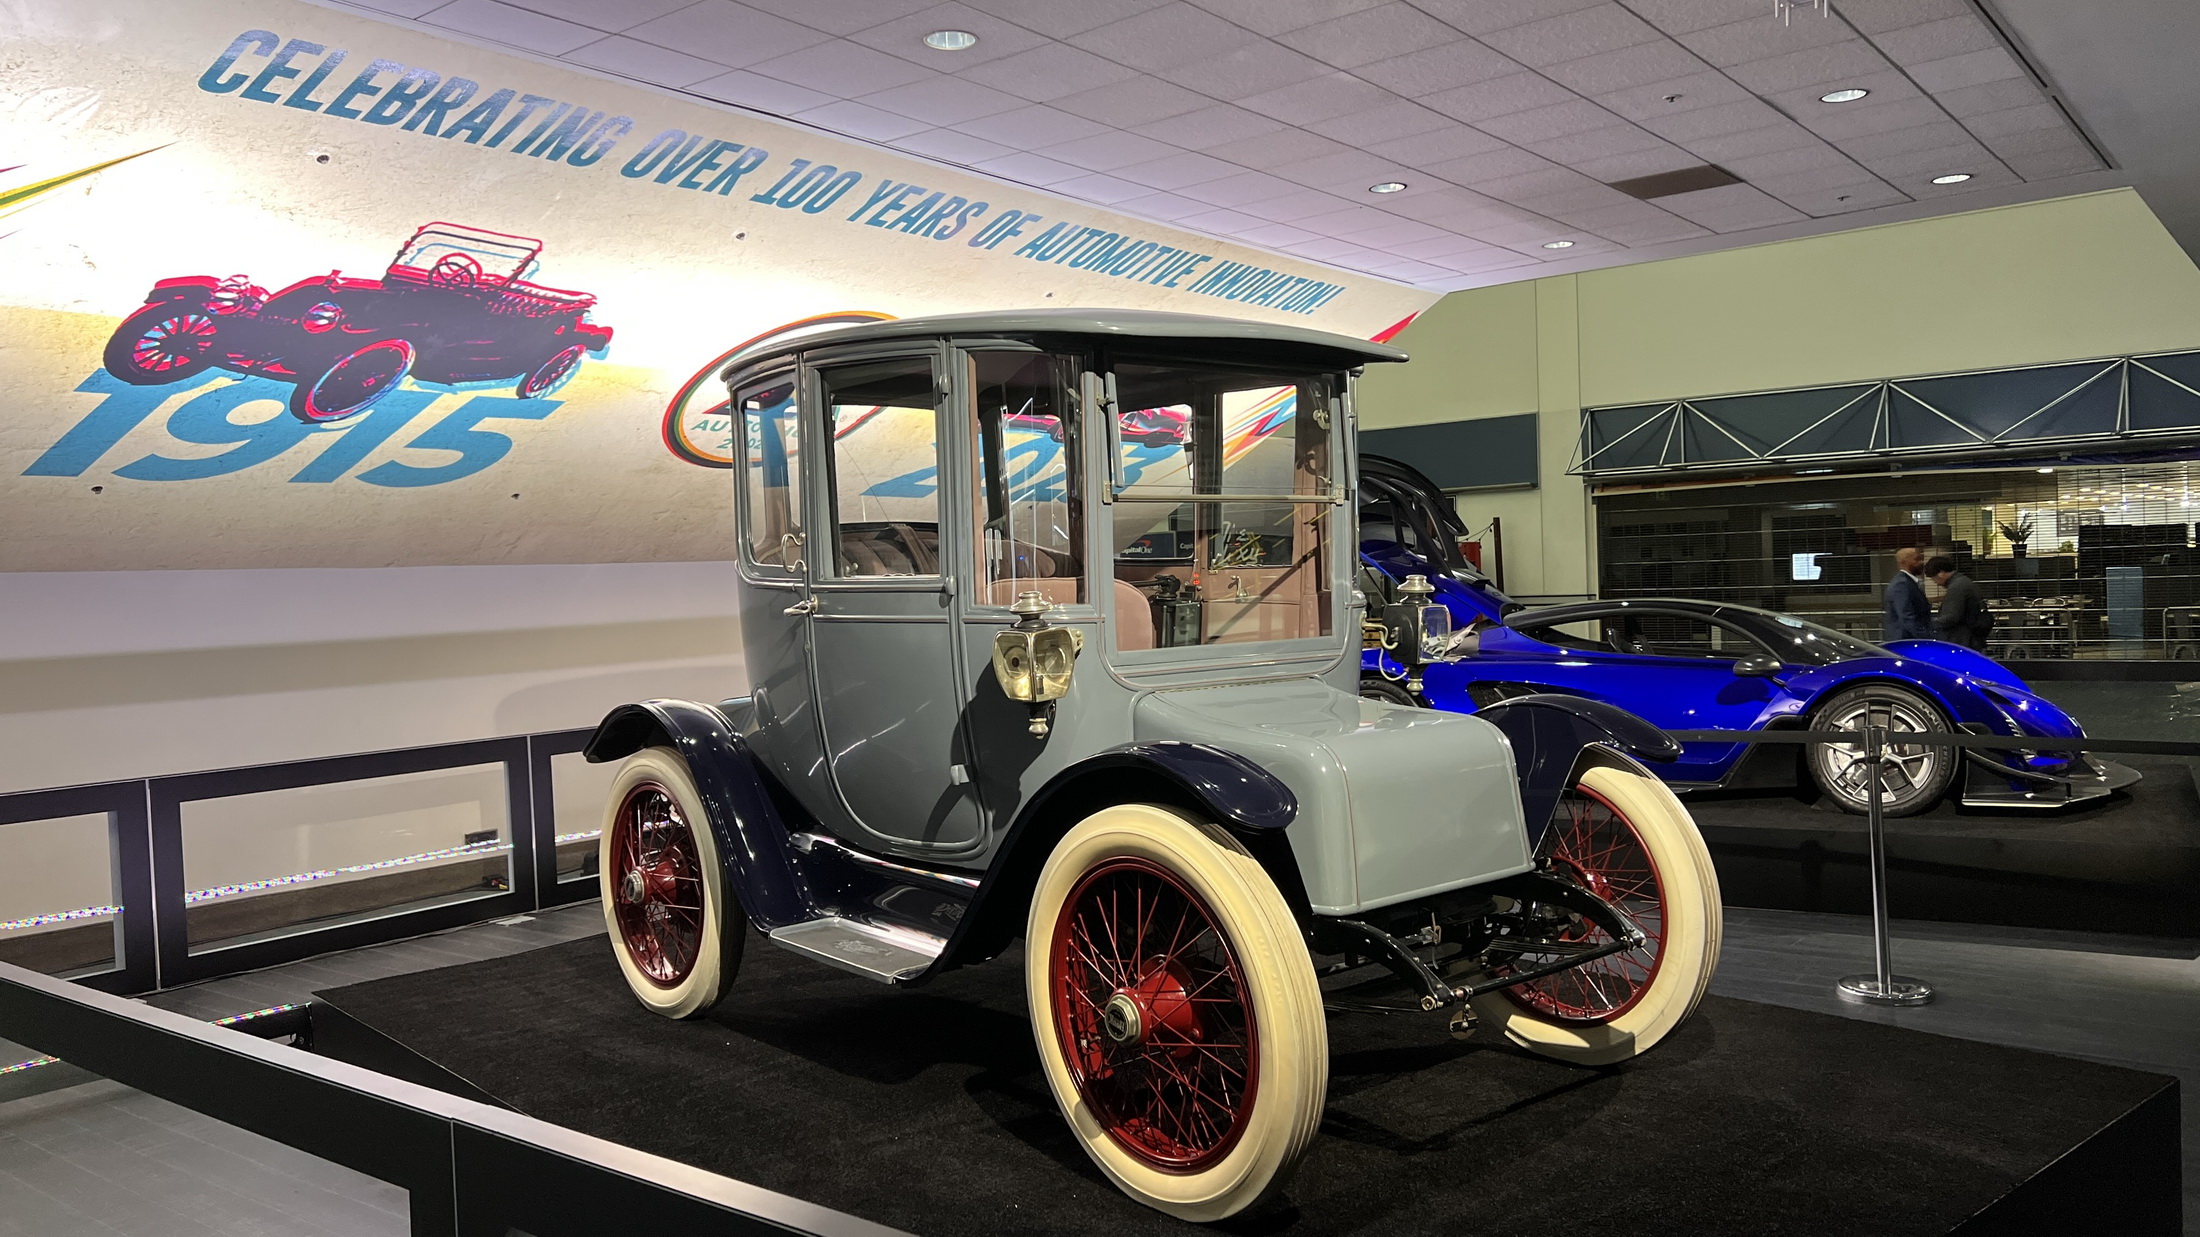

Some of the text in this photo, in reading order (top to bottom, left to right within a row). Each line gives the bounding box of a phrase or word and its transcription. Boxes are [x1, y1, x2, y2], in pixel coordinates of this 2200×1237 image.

[198, 29, 1346, 316] CELEBRATING OVER 100 YEARS OF AUTOMOTIVE INNOVATION!
[20, 366, 567, 488] 1915
[690, 419, 761, 433] AUO
